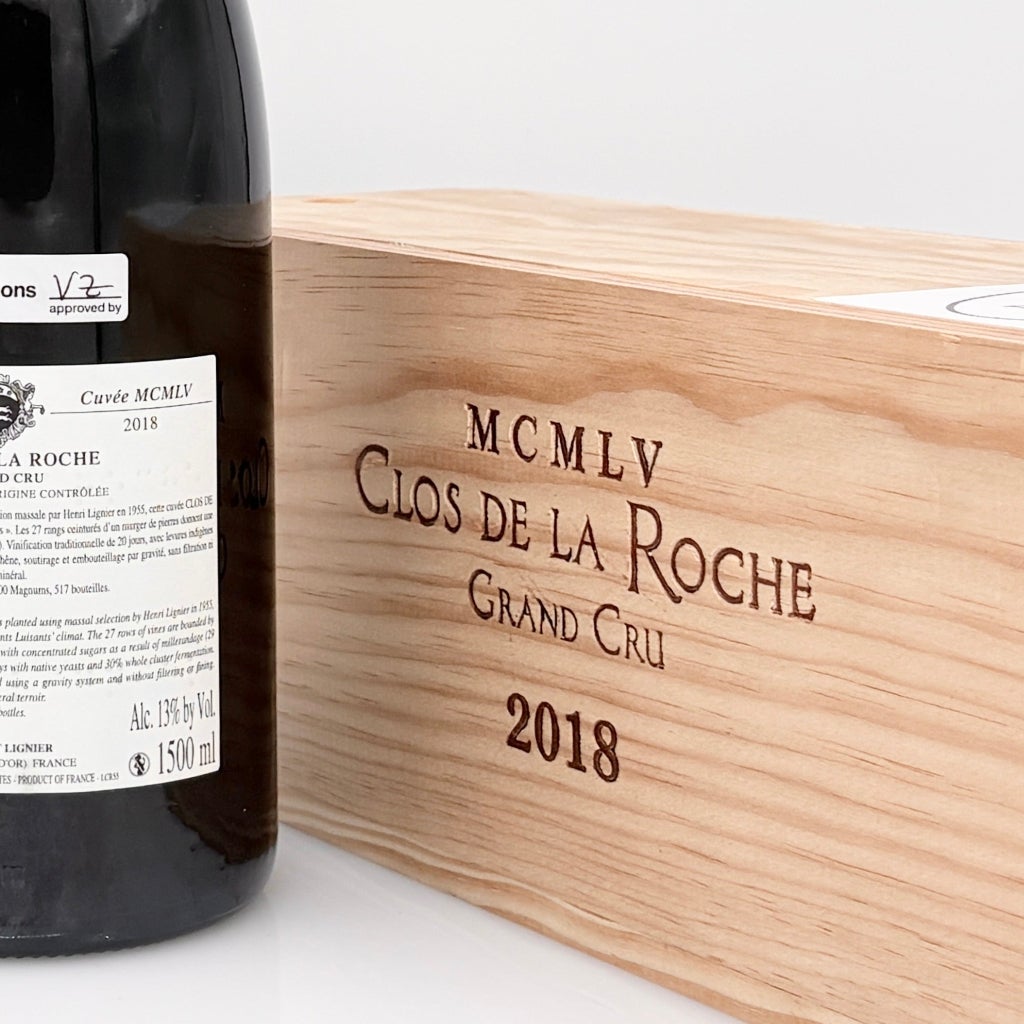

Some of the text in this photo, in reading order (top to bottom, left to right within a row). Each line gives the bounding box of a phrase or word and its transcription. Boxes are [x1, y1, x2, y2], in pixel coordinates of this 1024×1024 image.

[49, 303, 122, 315] approved by
[80, 383, 193, 405] Cuvée MCMLV
[123, 416, 158, 432] 2018
[465, 403, 663, 488] MCMLV
[29, 451, 101, 467] ROCHE
[13, 472, 44, 483] CRU
[39, 485, 110, 499] CONTRÔLÉE
[14, 509, 46, 519] massale
[48, 512, 61, 521] par
[63, 508, 85, 518] Henri
[116, 508, 126, 516] en
[128, 504, 147, 517] 1955,
[15, 525, 29, 534] Les
[31, 524, 41, 534] 27
[43, 527, 65, 536] rangs
[355, 444, 462, 534] CLOS
[480, 491, 531, 551] DE
[550, 508, 604, 572] LA
[626, 500, 817, 623] ROCHE
[6, 539, 52, 549] Vinification
[23, 554, 59, 567] soutirage
[71, 551, 125, 566] embouteillage
[9, 584, 52, 596] Magnums,
[54, 584, 68, 593] 517
[70, 581, 110, 593] bouteilles.
[4, 616, 38, 628] planted
[39, 616, 63, 628] using
[64, 614, 94, 625] massal
[94, 611, 131, 624] selection
[469, 568, 665, 670] GRAND CRU
[86, 628, 103, 639] The
[103, 628, 115, 638] 27
[0, 646, 20, 656] with
[21, 645, 78, 656] concentrated
[79, 646, 107, 657] sugars
[9, 661, 30, 670] with
[30, 660, 58, 670] native
[58, 659, 86, 672] yeasts
[5, 676, 30, 688] using
[42, 675, 73, 688] gravity
[75, 673, 105, 687] system
[130, 689, 216, 731] Alc. 13% by Vol.
[506, 693, 620, 783] 2018
[4, 742, 52, 752] LIGNIER
[158, 730, 216, 775] 1500 ml
[32, 757, 76, 767] FRANCE
[17, 774, 53, 783] PRODUCT
[54, 773, 64, 783] OF
[66, 771, 95, 782] FRANCE
